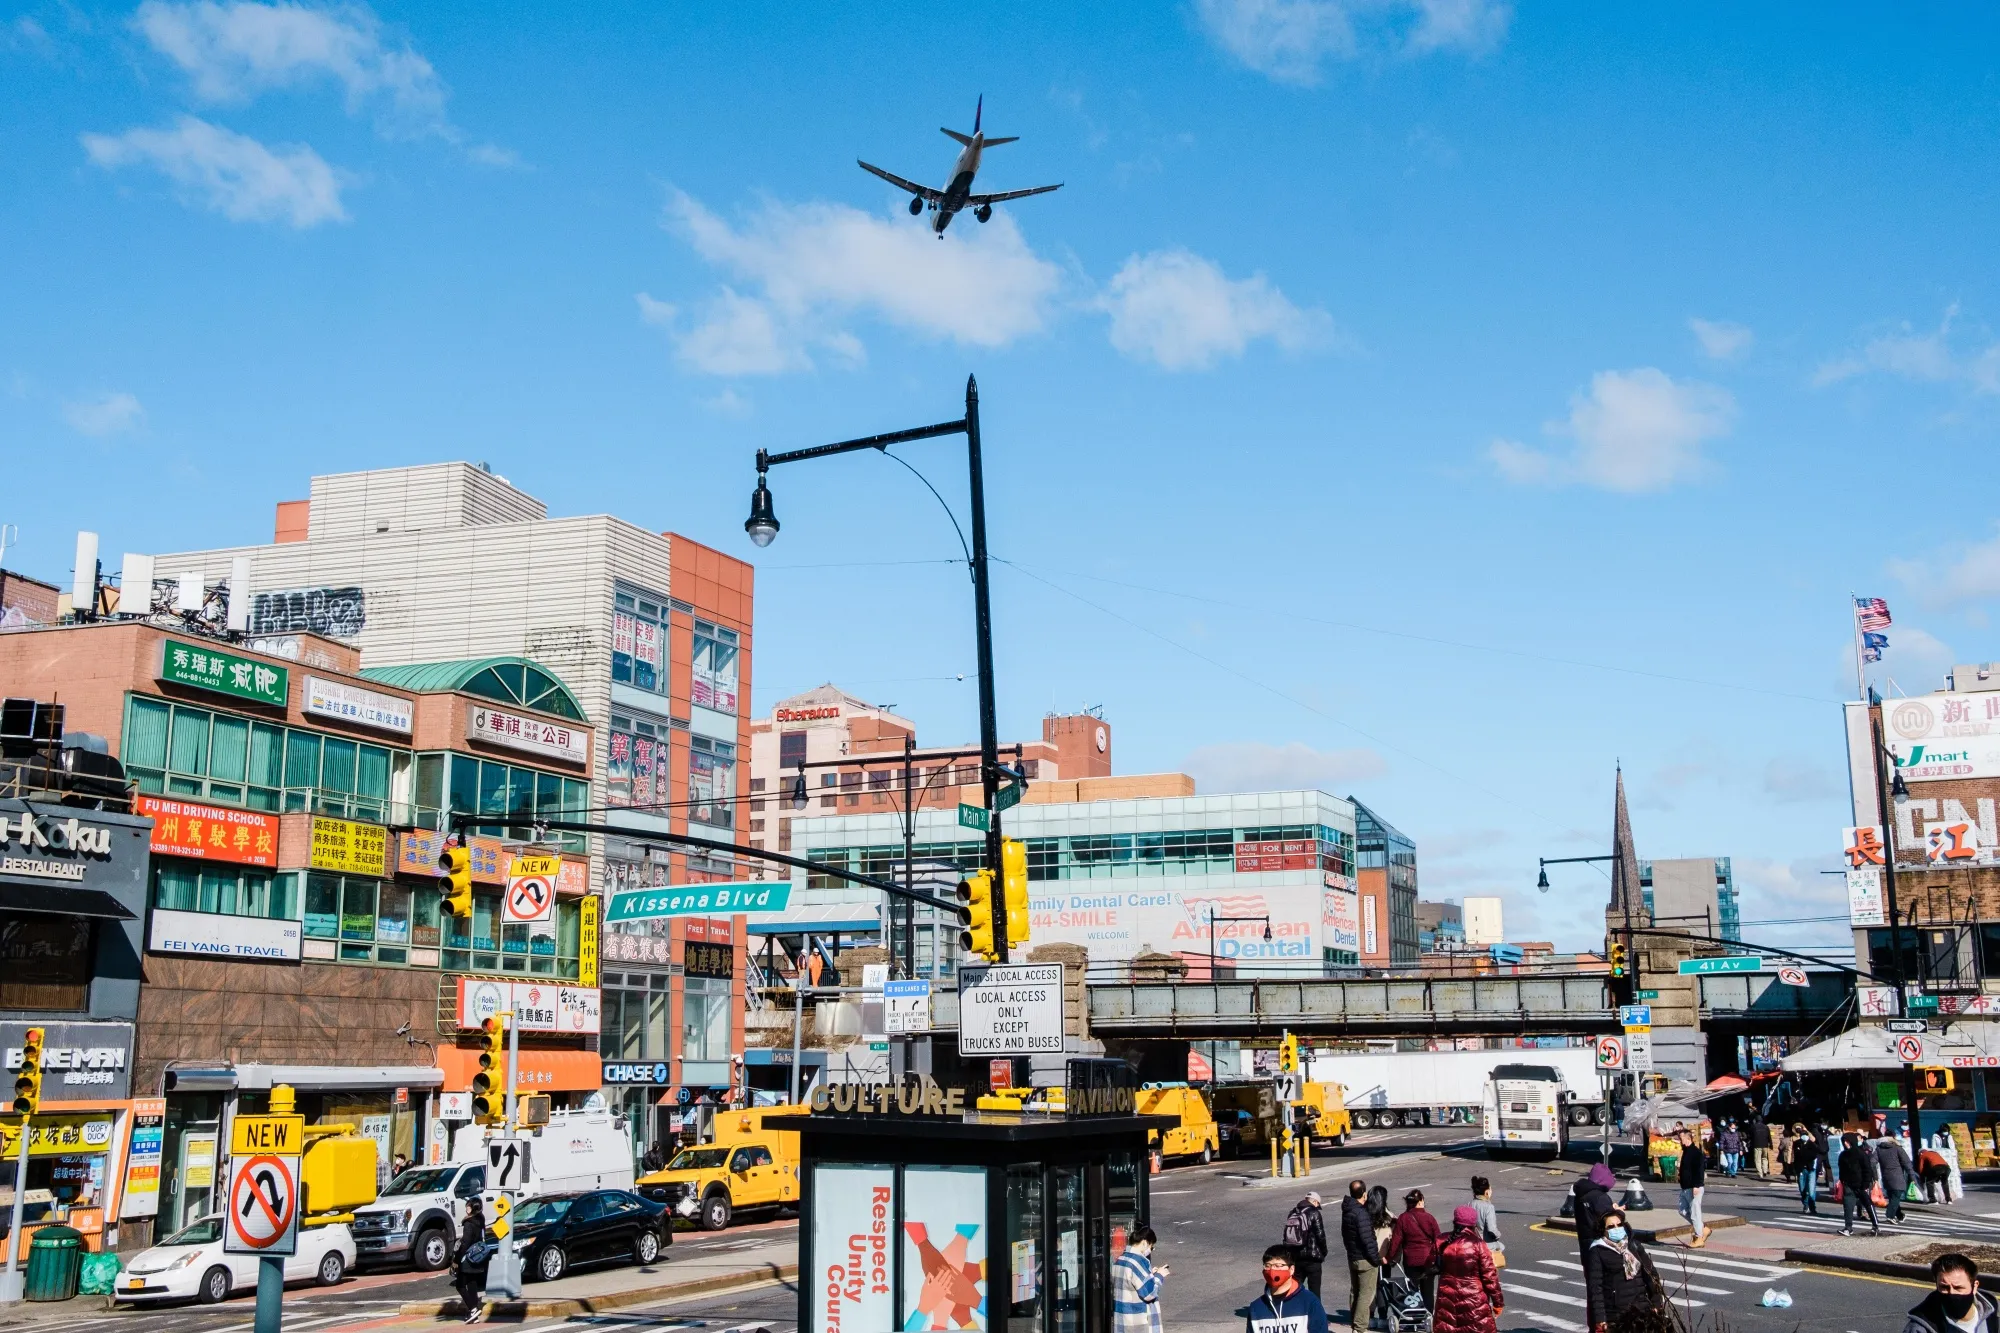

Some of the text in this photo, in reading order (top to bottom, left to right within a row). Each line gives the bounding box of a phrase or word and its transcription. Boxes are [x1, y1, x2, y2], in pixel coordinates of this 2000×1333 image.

[776, 706, 840, 722] Sheraton
[542, 726, 570, 748] 公司
[1943, 723, 1990, 737] NEW
[145, 800, 267, 827] FU MEI DRIVING SCHOOL
[963, 807, 979, 826] Main
[149, 815, 272, 854] 州駕駛學校
[1262, 844, 1303, 853] FOR RENT
[3, 858, 86, 879] RESTAURANT
[520, 860, 550, 873] NEW
[624, 889, 770, 914] Kissena Blvd
[1027, 893, 1171, 912] amily Dental Care!
[1323, 911, 1357, 931] American
[687, 924, 730, 936] FREE TRIAL
[1088, 931, 1130, 940] WELCOME
[1172, 920, 1310, 940] American
[1335, 929, 1357, 947] Dental
[164, 940, 287, 957] FEI YANG TRAVEL
[1220, 936, 1310, 958] Dental
[1699, 959, 1740, 971] 41 Av
[963, 969, 1058, 983] Main St LOCAL ACCESS
[975, 990, 1046, 1003] LOCAL ACCESS
[1914, 998, 1923, 1006] 41
[998, 1006, 1023, 1018] ONLY
[993, 1021, 1029, 1034] EXCEPT
[964, 1036, 1060, 1049] TRUCKS AND BUSES
[6, 1048, 125, 1068] BNEMAN
[604, 1064, 653, 1082] CHASE
[810, 1083, 1137, 1116] CULTURE PAVILION
[87, 1124, 109, 1133] TOOFY
[88, 1132, 106, 1140] DUCK
[246, 1123, 288, 1148] NEW
[872, 1186, 891, 1295] Respect
[844, 1234, 867, 1304] Unity
[1259, 1323, 1299, 1333] TOMMY
